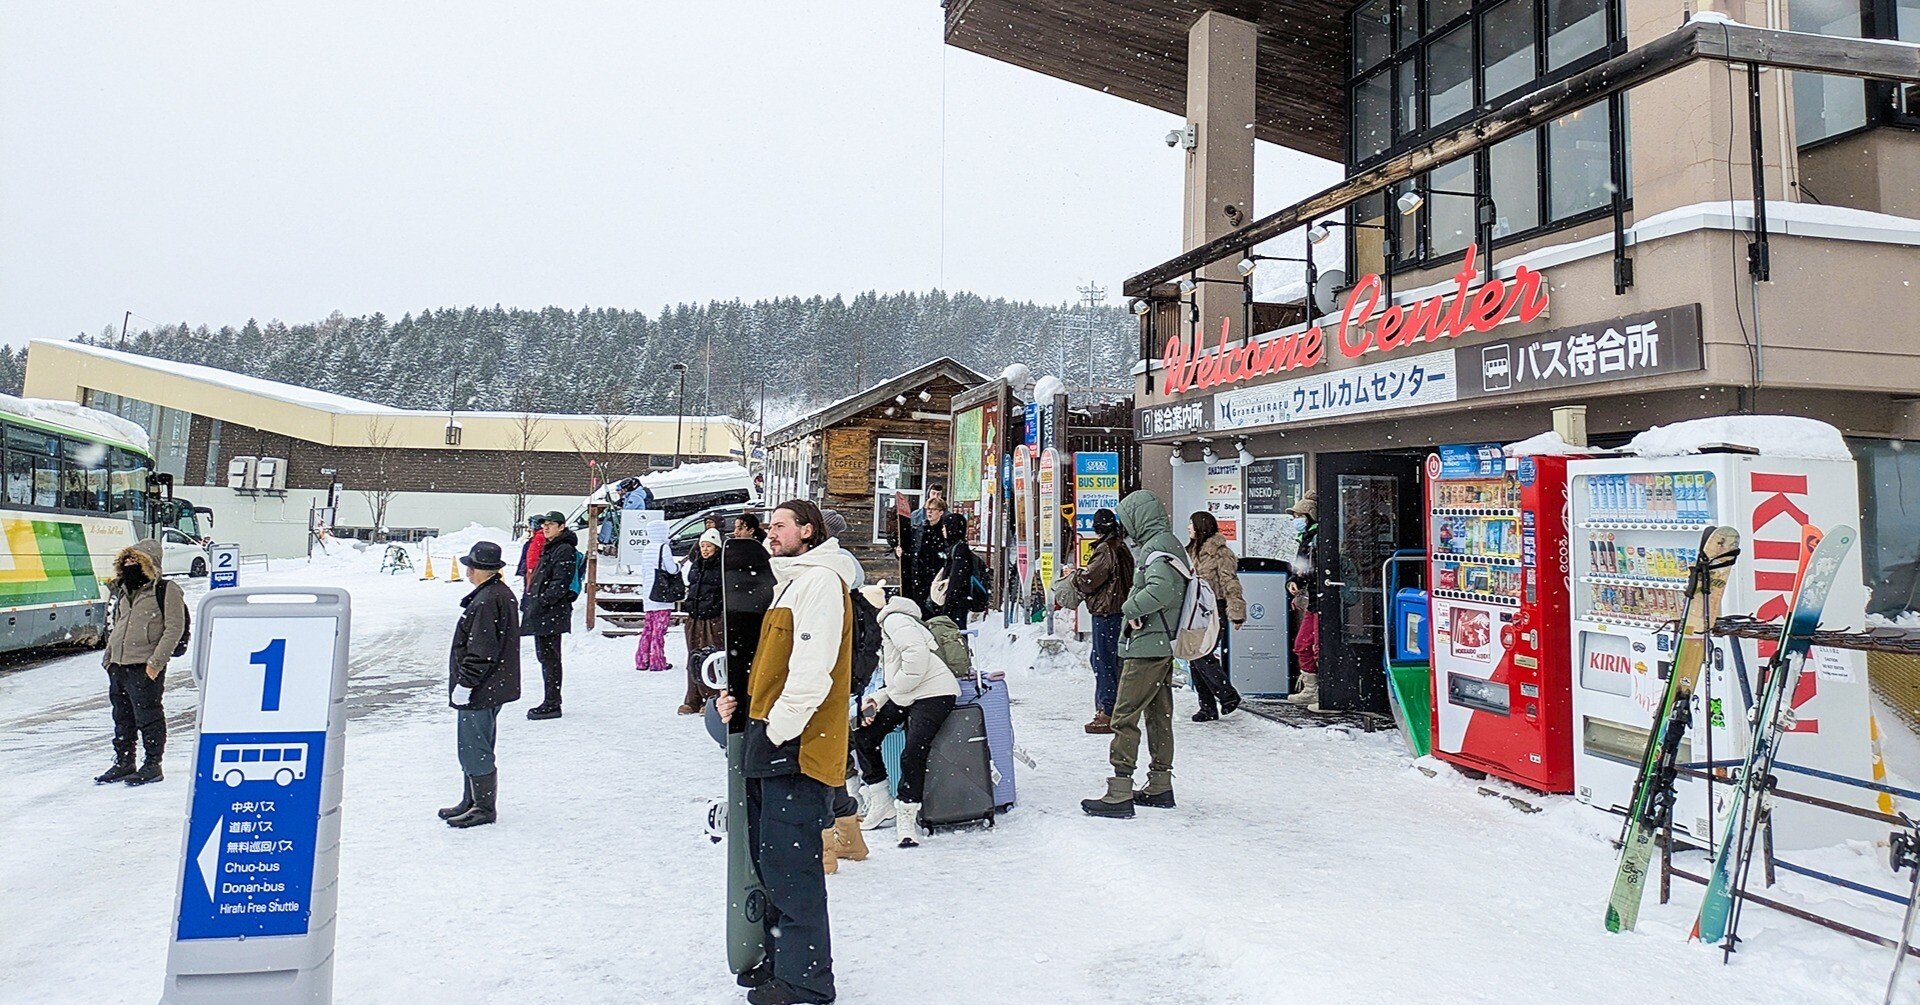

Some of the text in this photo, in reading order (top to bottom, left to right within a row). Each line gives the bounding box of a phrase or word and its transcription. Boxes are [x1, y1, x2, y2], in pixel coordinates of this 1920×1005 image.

[1163, 243, 1550, 396] Welcome Center
[1515, 320, 1659, 383] バス待合所
[1293, 364, 1446, 413] ウェルカムセンター
[1231, 400, 1289, 418] Grand HIRAFU
[1153, 401, 1203, 434] 総合案内所
[833, 460, 864, 469] COFFEE
[1078, 477, 1117, 488] BUS STOP
[1248, 487, 1272, 498] NISEKO
[1078, 498, 1117, 508] WHITE LINER
[1224, 503, 1240, 511] Style
[218, 553, 232, 567] 2
[1589, 651, 1631, 674] KIRIN
[249, 638, 286, 712] 1
[231, 801, 276, 813] 中央バス
[228, 821, 273, 833] 道南バス
[226, 840, 293, 853] 無料巡回バス
[224, 862, 280, 873] Chuo-bus
[222, 882, 286, 894] Donan-bus
[219, 901, 300, 914] Hirafu Free Shuttle
